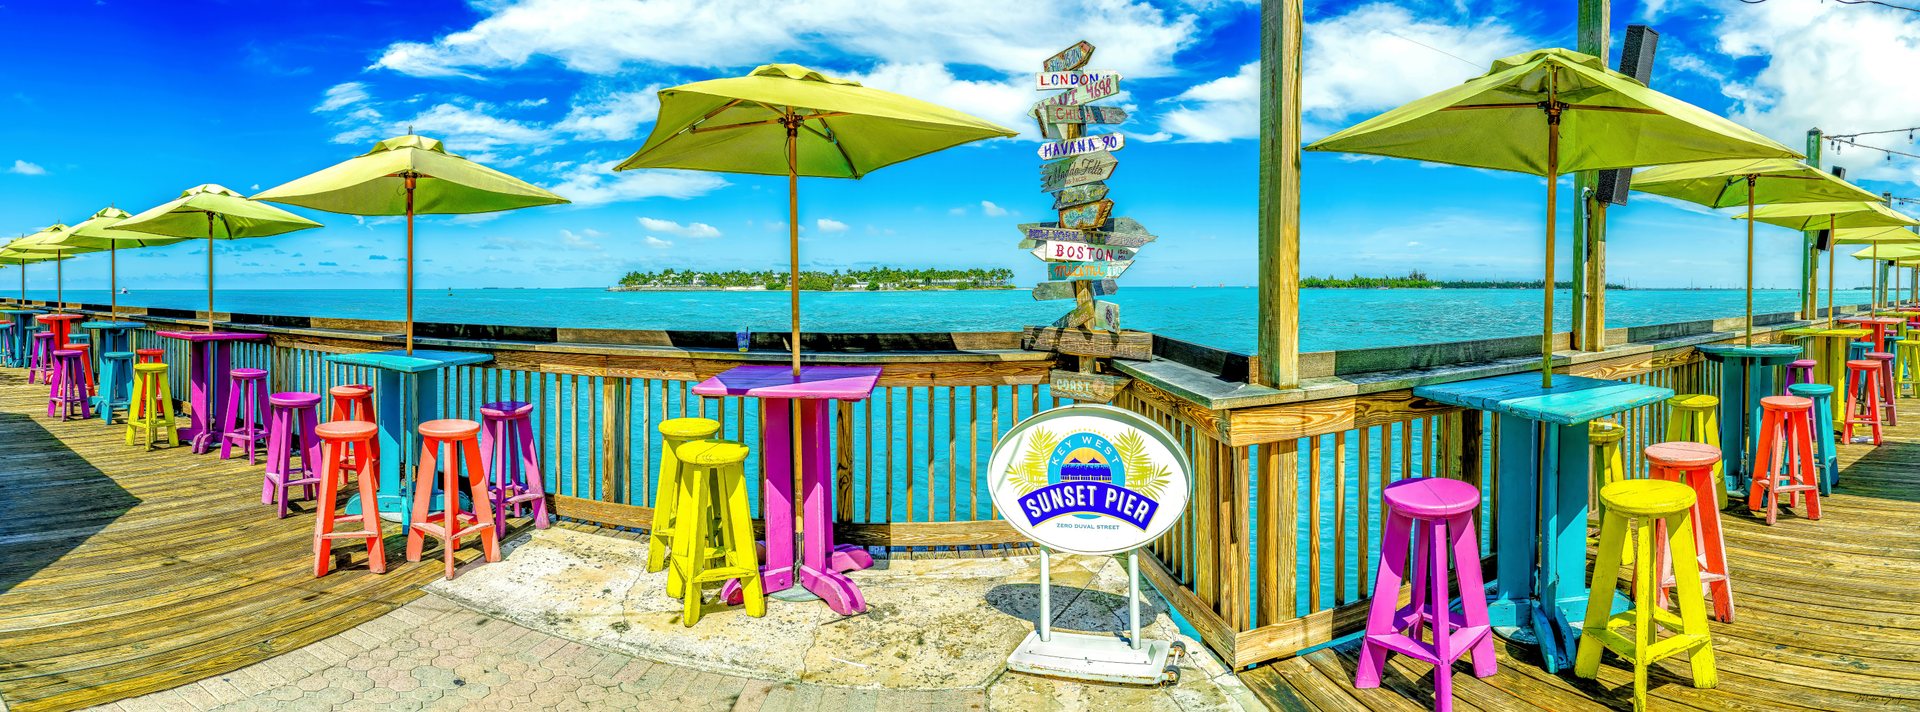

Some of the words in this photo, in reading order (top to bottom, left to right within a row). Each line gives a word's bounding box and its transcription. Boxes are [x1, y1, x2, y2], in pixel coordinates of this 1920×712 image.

[1040, 73, 1099, 86] LONDON
[1044, 137, 1096, 157] HAVANA
[1102, 135, 1117, 150] 90
[1055, 244, 1114, 261] BOSTON
[1056, 379, 1090, 392] COAST
[1052, 440, 1072, 466] KEY
[1081, 435, 1120, 463] WEST
[1025, 484, 1097, 519] SUNSET
[1105, 487, 1150, 524] PIER
